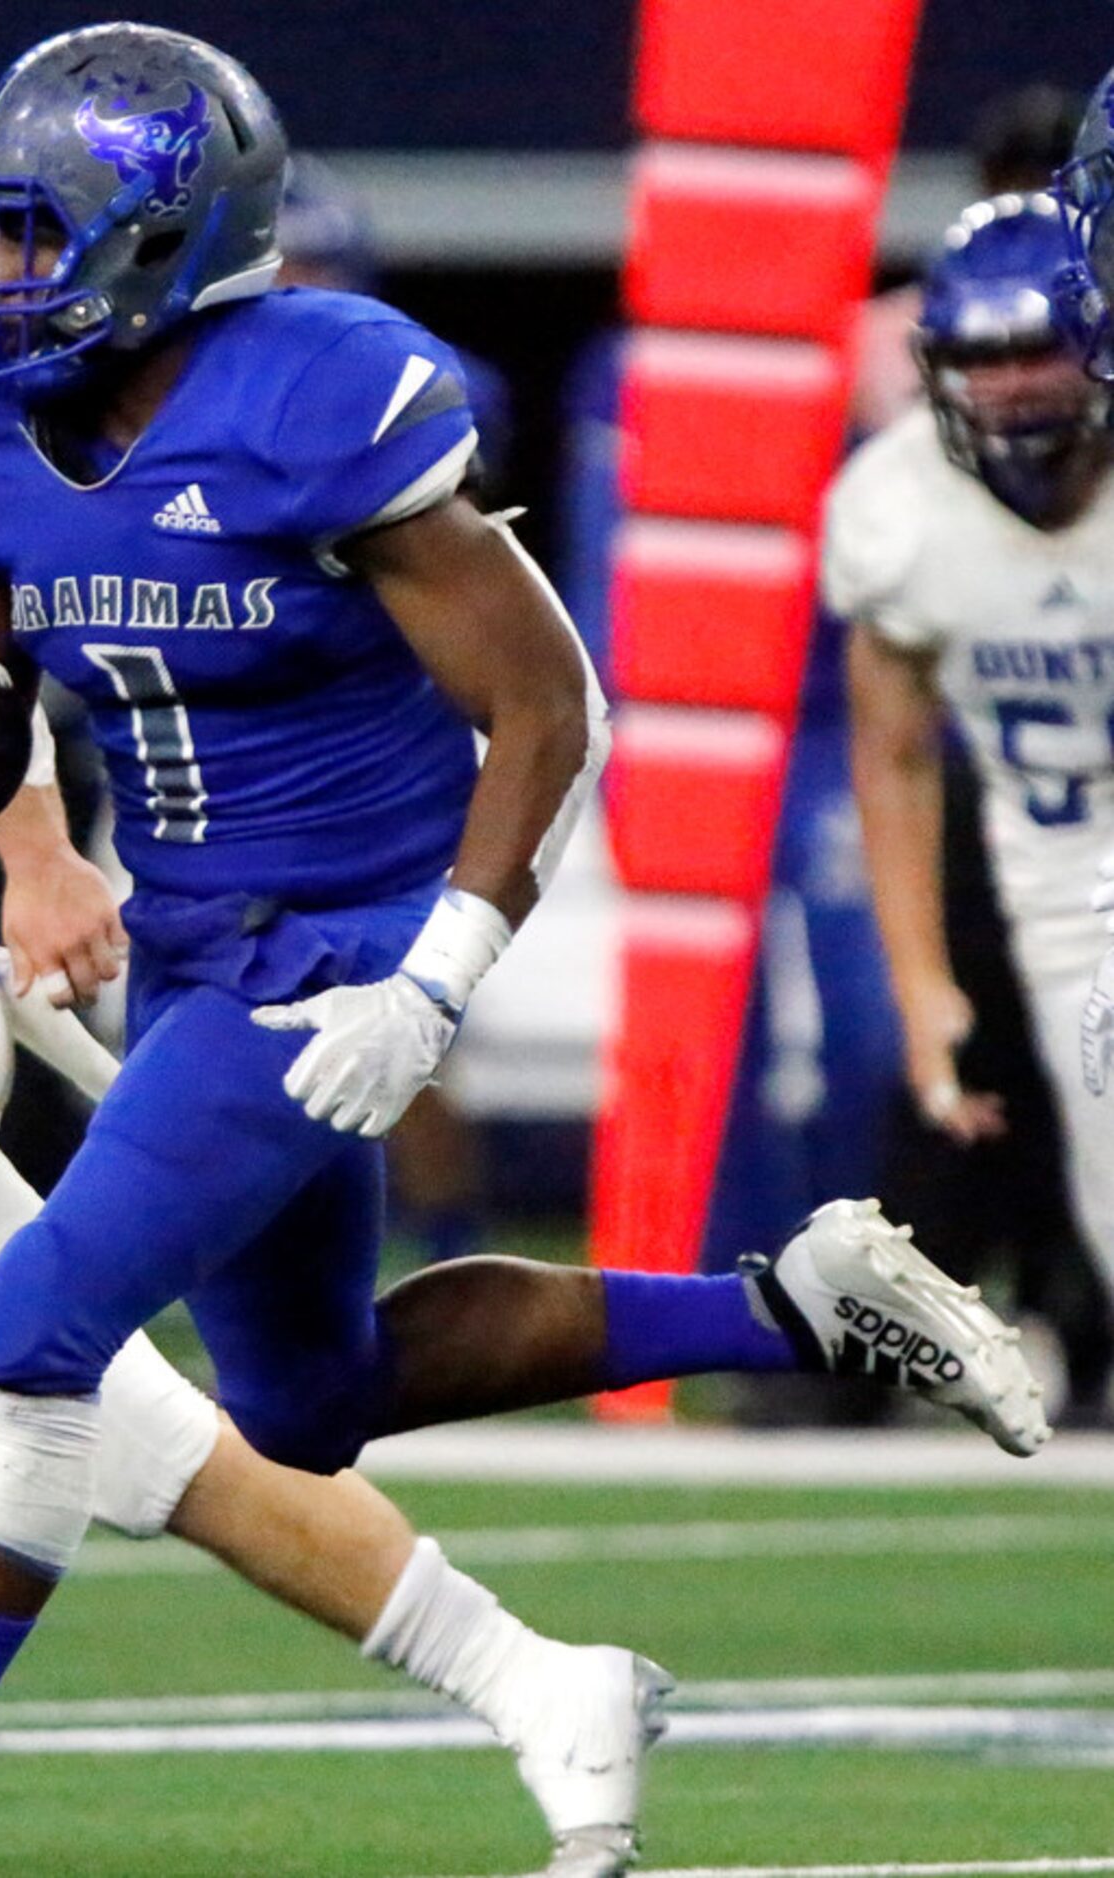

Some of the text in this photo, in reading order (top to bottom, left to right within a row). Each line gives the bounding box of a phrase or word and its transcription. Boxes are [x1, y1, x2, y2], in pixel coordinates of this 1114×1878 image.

[153, 511, 221, 533] adidas
[81, 643, 209, 843] 1
[834, 1296, 965, 1382] adidas
